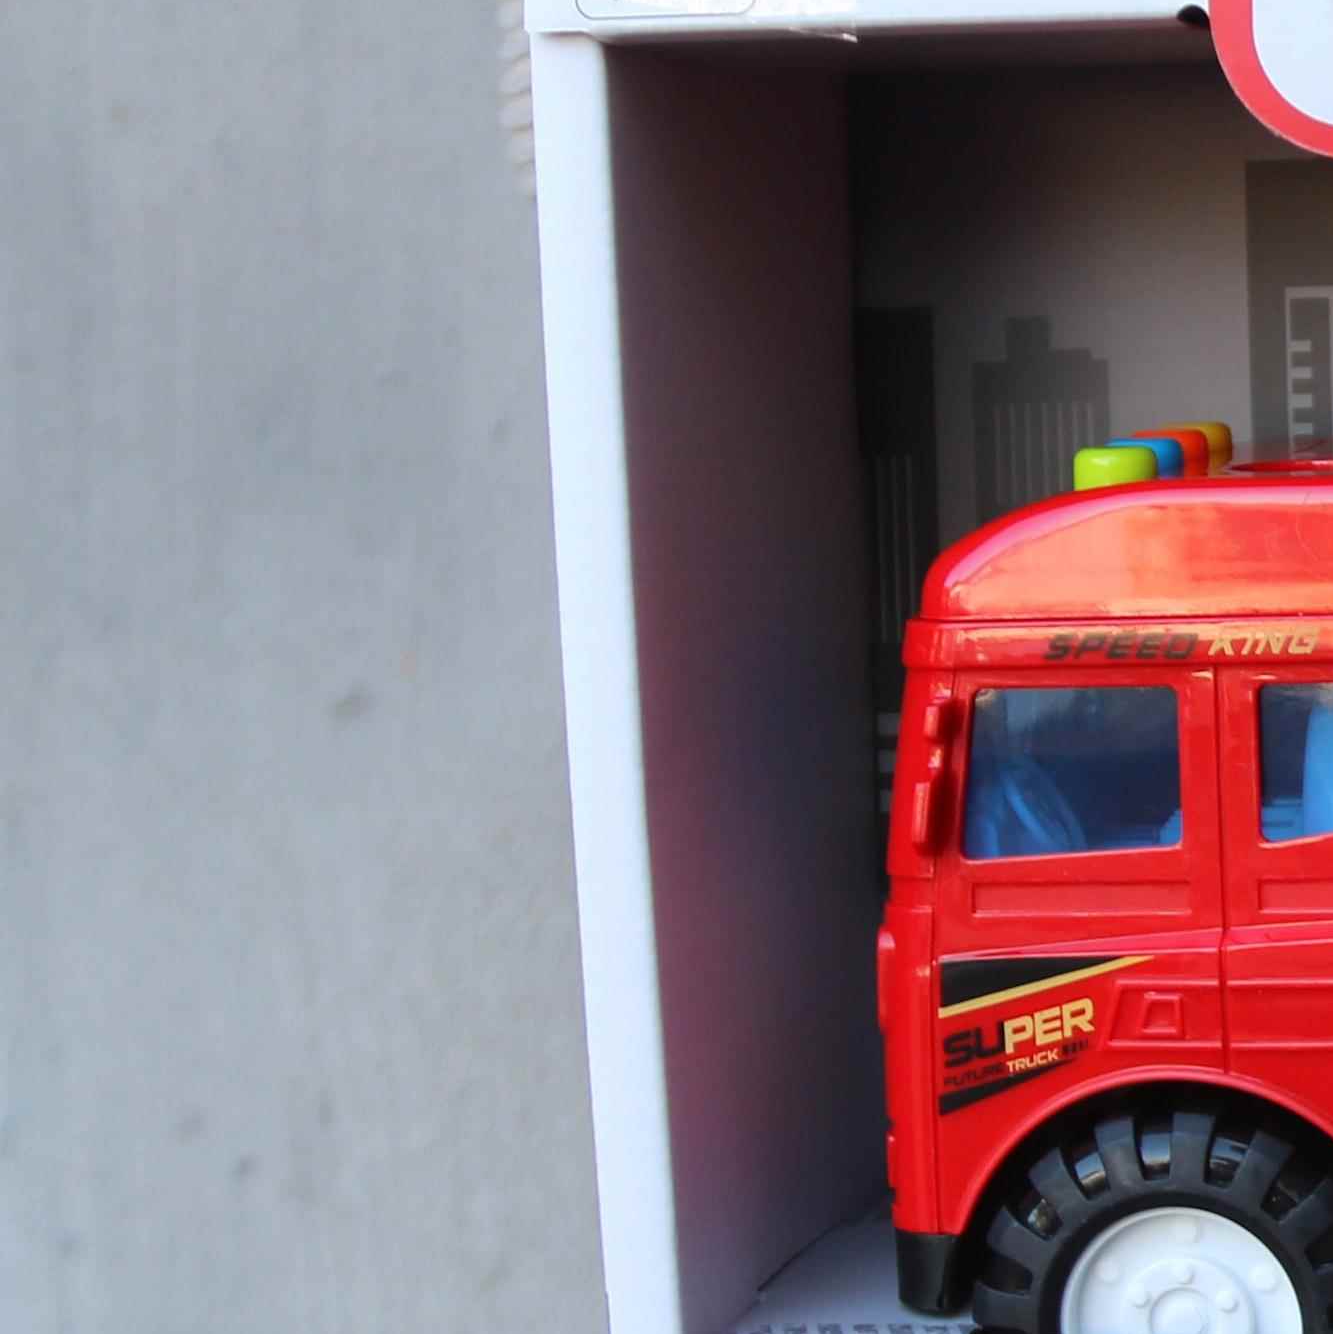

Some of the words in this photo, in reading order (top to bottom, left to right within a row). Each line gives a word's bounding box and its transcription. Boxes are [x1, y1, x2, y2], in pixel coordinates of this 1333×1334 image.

[1043, 631, 1198, 660] SPEED
[1207, 628, 1318, 656] KING
[943, 997, 1096, 1068] SUPER
[1005, 1048, 1060, 1074] TRUCK
